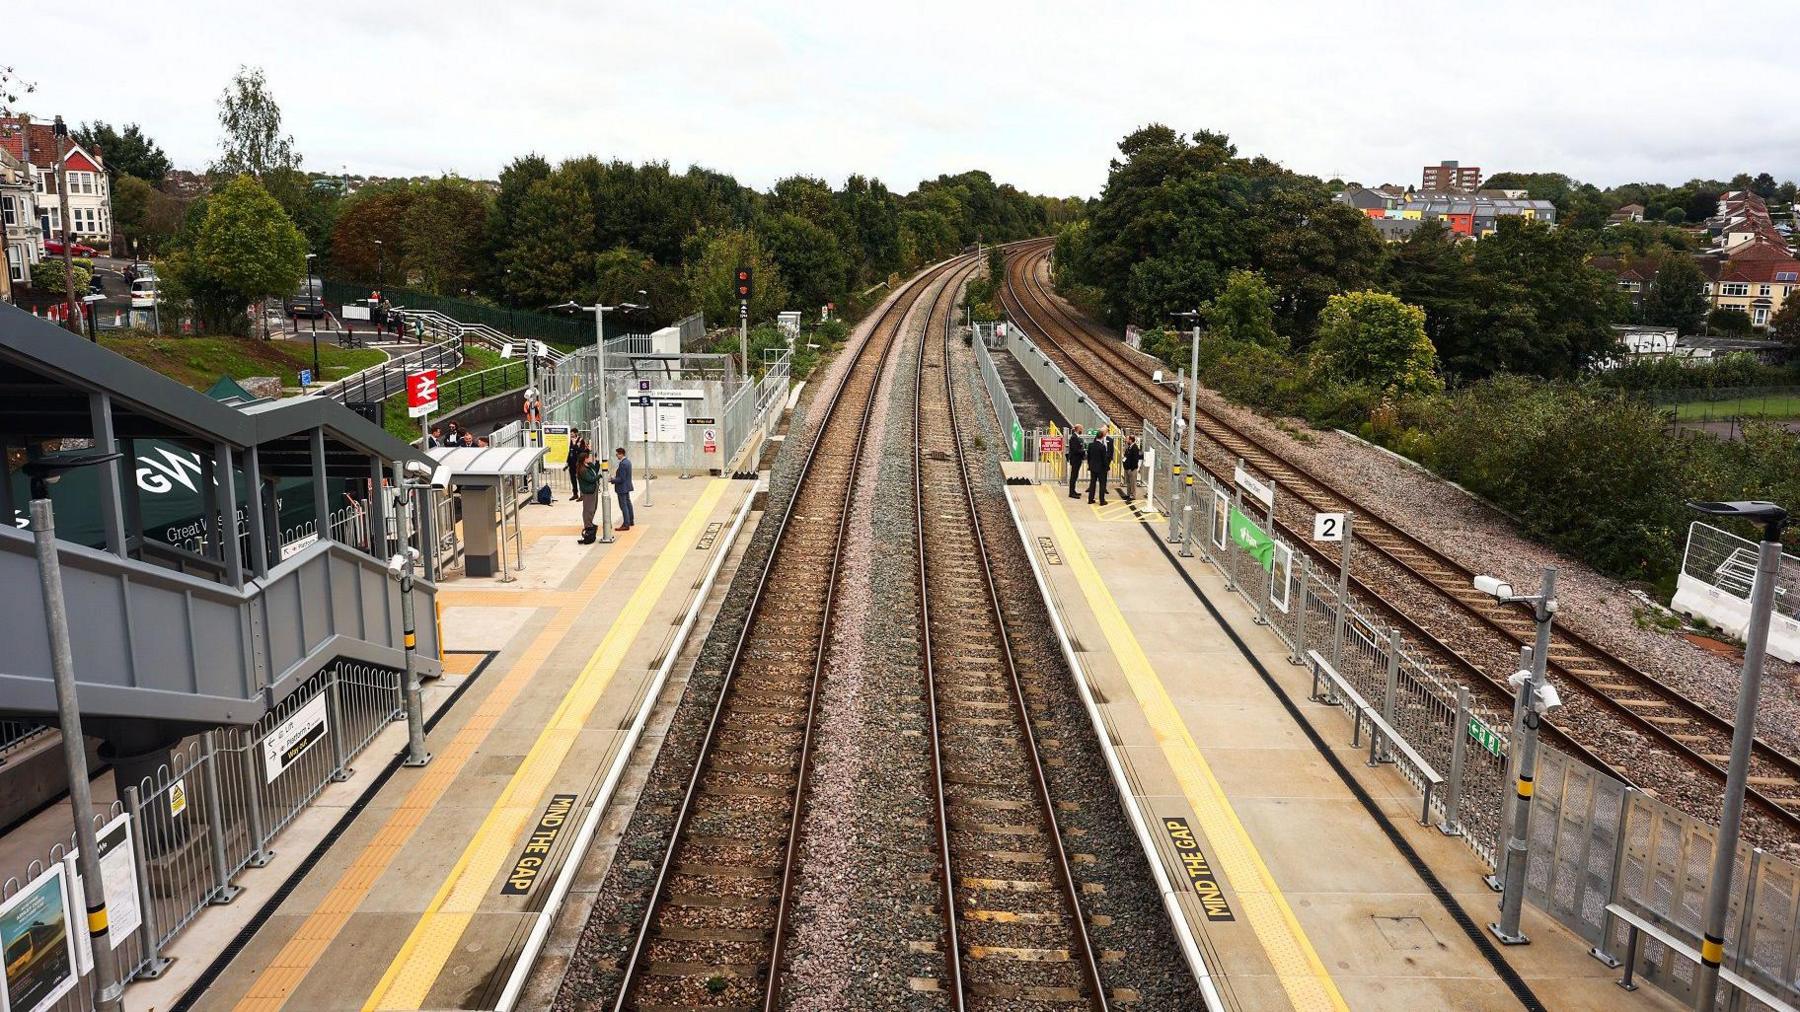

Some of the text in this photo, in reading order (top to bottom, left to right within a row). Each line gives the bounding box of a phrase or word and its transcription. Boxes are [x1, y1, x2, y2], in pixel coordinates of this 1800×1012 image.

[136, 447, 243, 494] GW
[167, 521, 201, 543] Great
[1322, 518, 1336, 537] 2
[284, 721, 294, 733] Lift
[286, 727, 307, 748] Platform
[306, 722, 311, 730] 2
[287, 738, 308, 760] Way out
[509, 798, 574, 890] MIND THE GAP
[1166, 821, 1231, 916] MIND THE GAP
